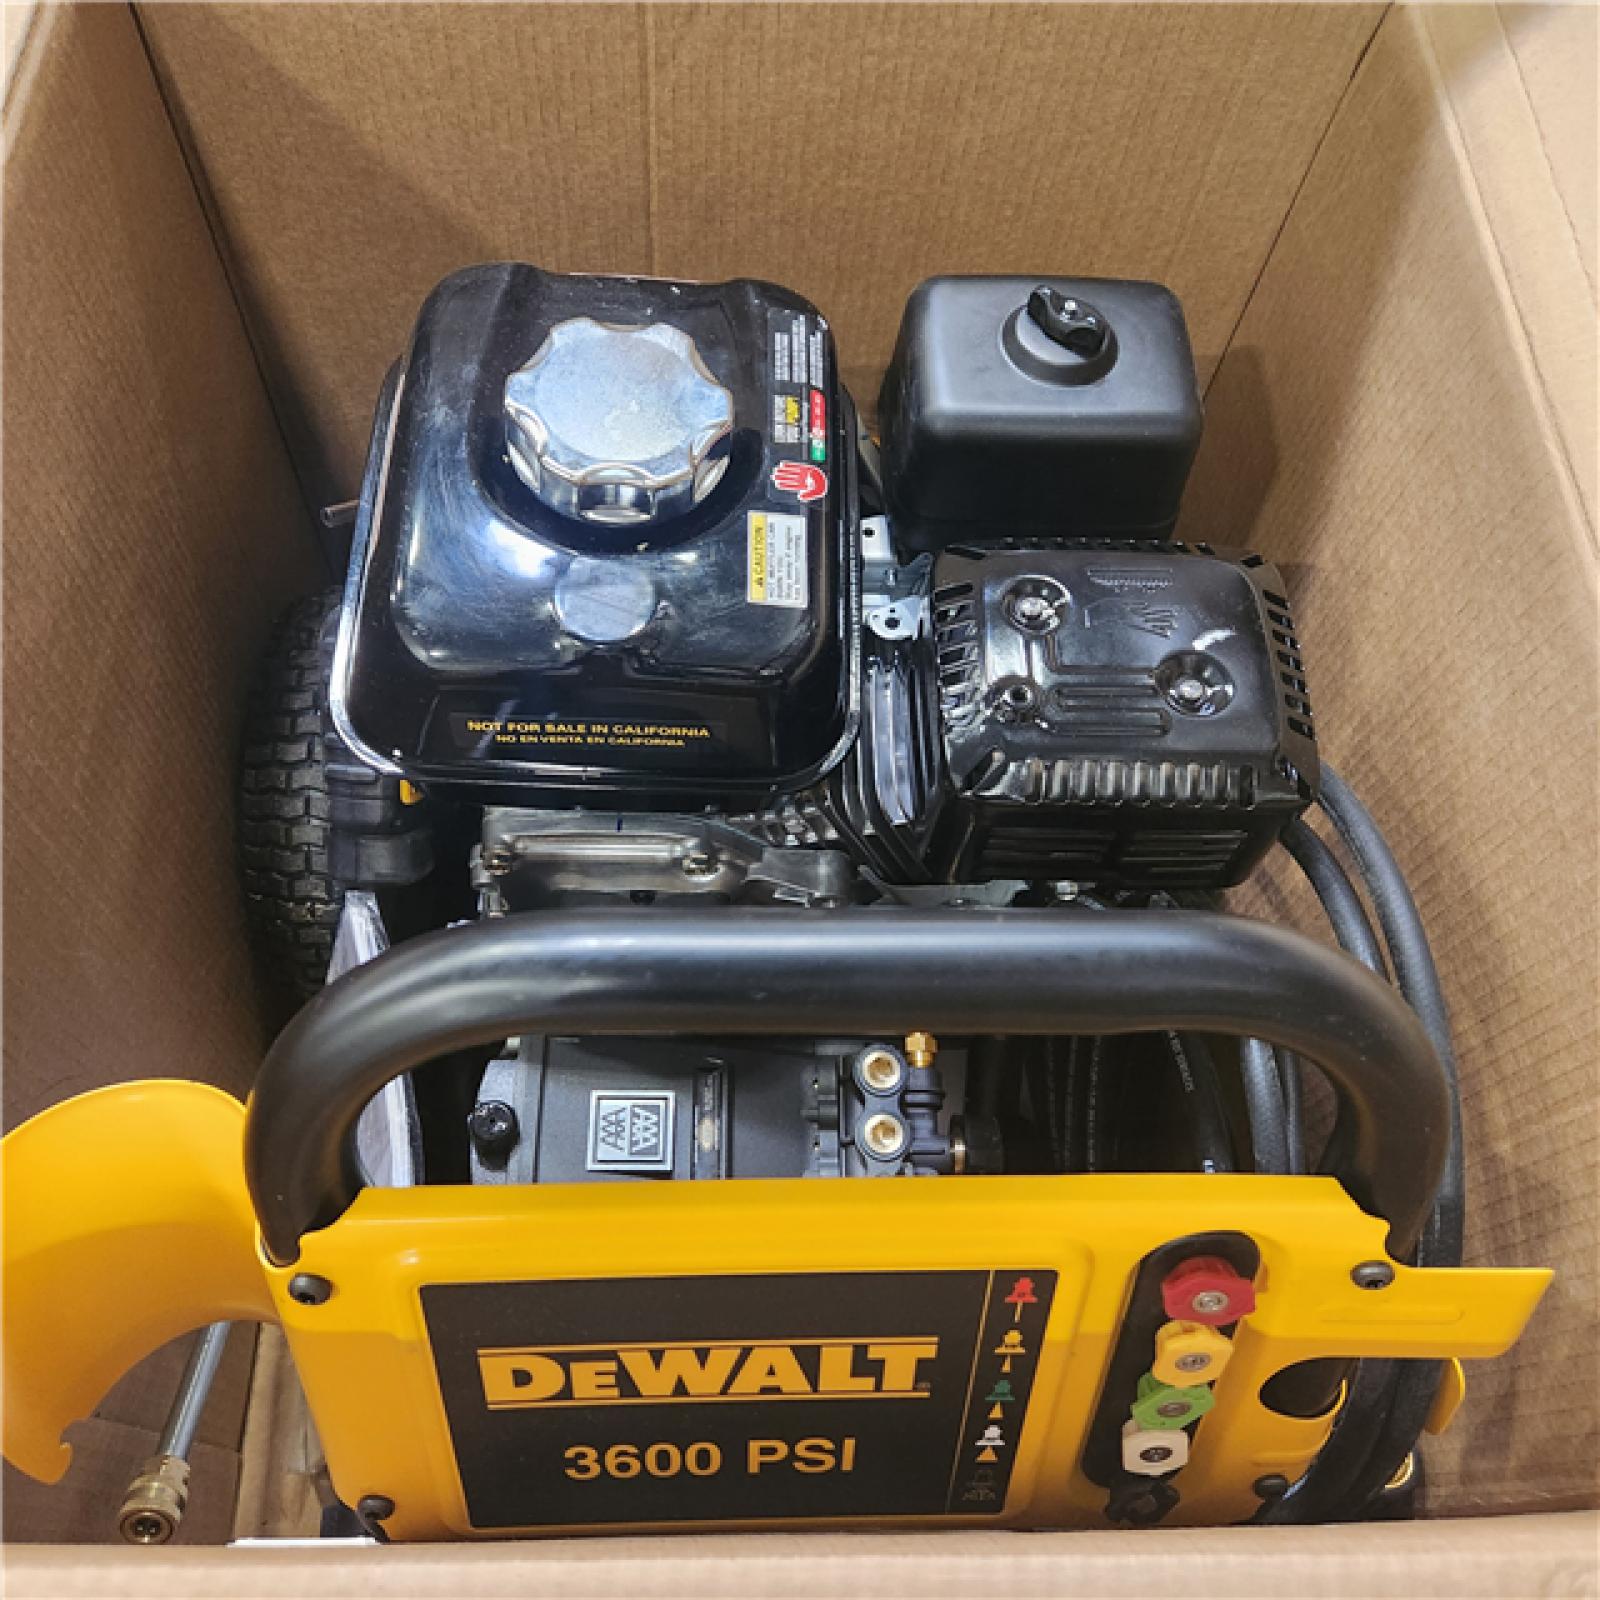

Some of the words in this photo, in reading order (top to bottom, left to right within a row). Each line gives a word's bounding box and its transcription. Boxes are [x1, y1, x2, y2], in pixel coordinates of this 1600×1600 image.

[467, 720, 502, 731] NOT
[507, 721, 541, 733] FOR
[545, 722, 586, 734] SALE
[591, 723, 609, 735] IN
[612, 723, 711, 738] CALIFORNIA
[496, 733, 516, 744] NO
[519, 734, 539, 744] EN
[540, 734, 584, 745] VENTA
[587, 735, 605, 745] EN
[607, 736, 686, 747] CALIFORNIA
[563, 1441, 722, 1482] 3600
[746, 1436, 857, 1474] PSI
